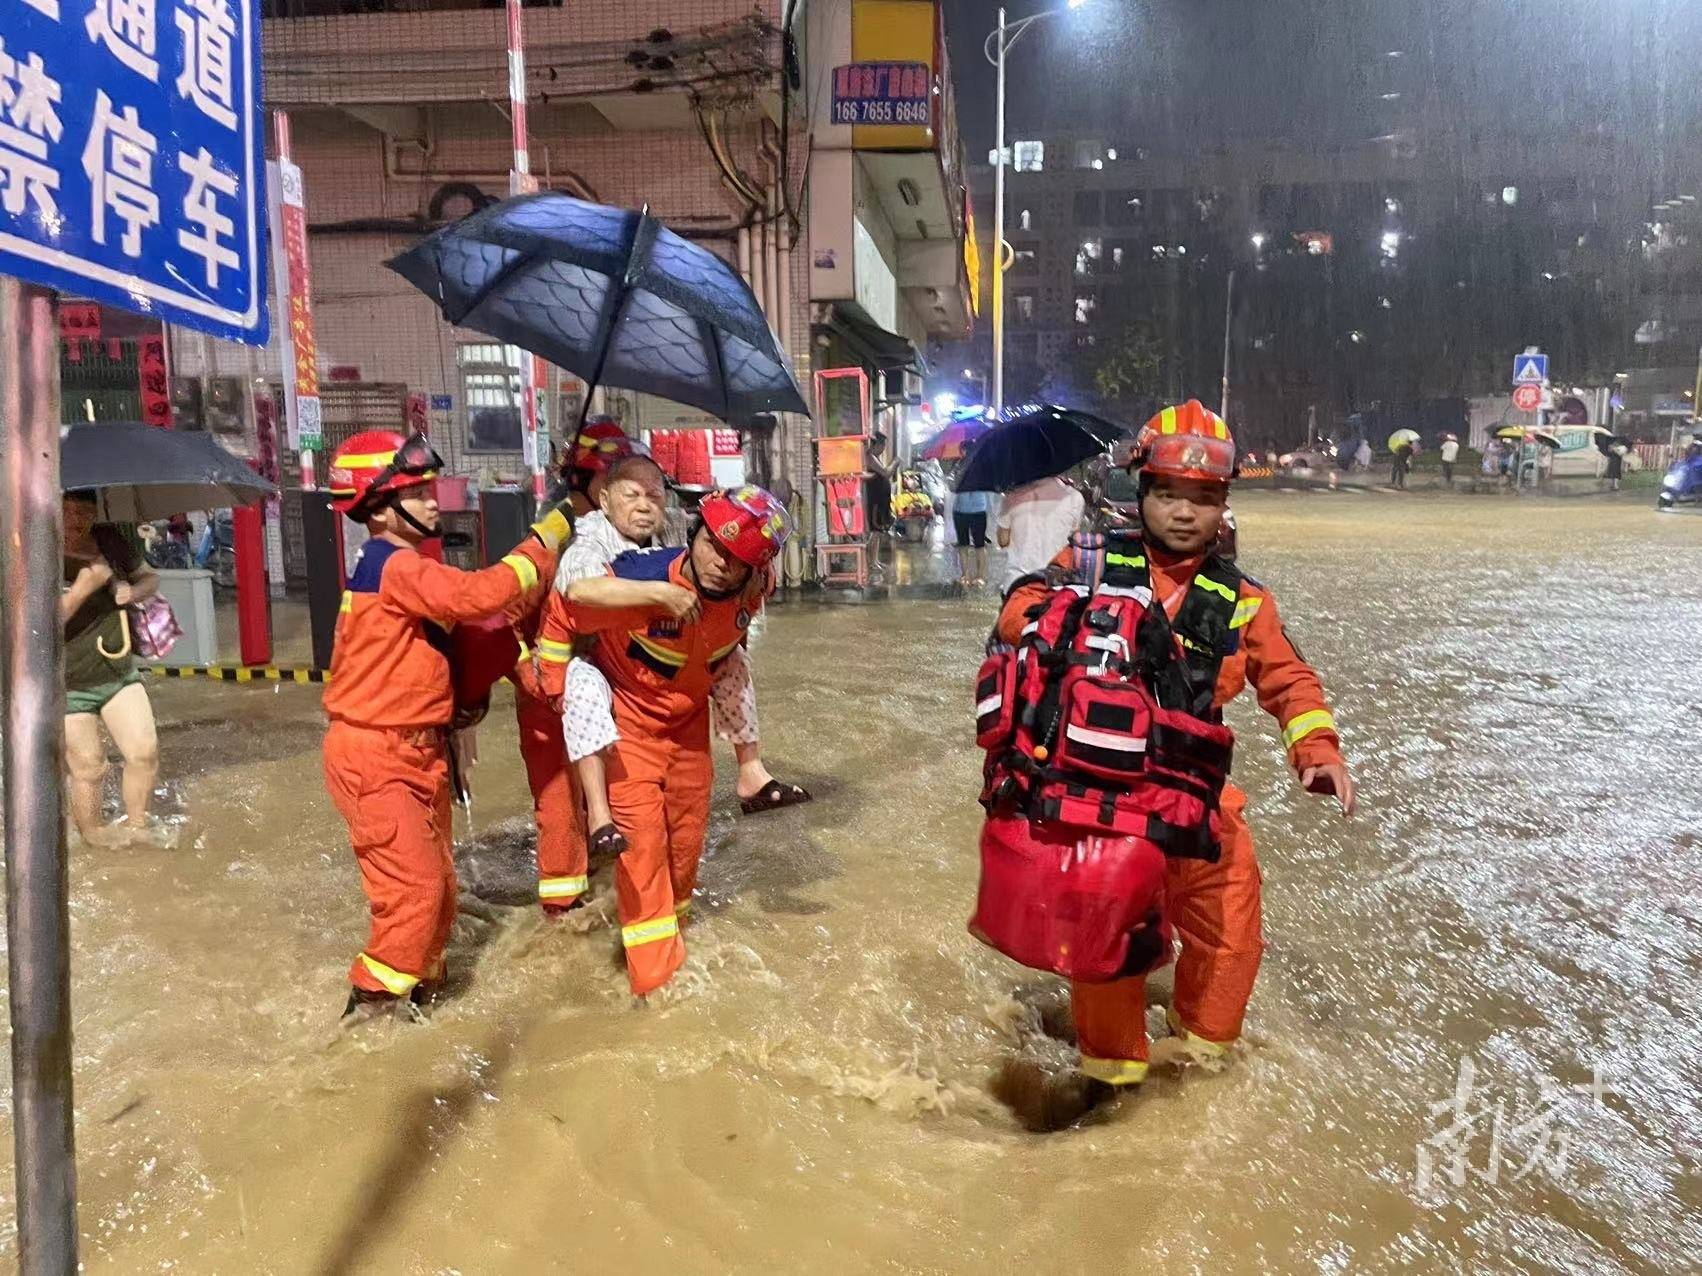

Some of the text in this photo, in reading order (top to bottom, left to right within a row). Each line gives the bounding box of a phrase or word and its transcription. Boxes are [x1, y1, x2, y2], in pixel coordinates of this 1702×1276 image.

[20, 0, 238, 131] 通道
[836, 101, 927, 121] 166 7655 6646
